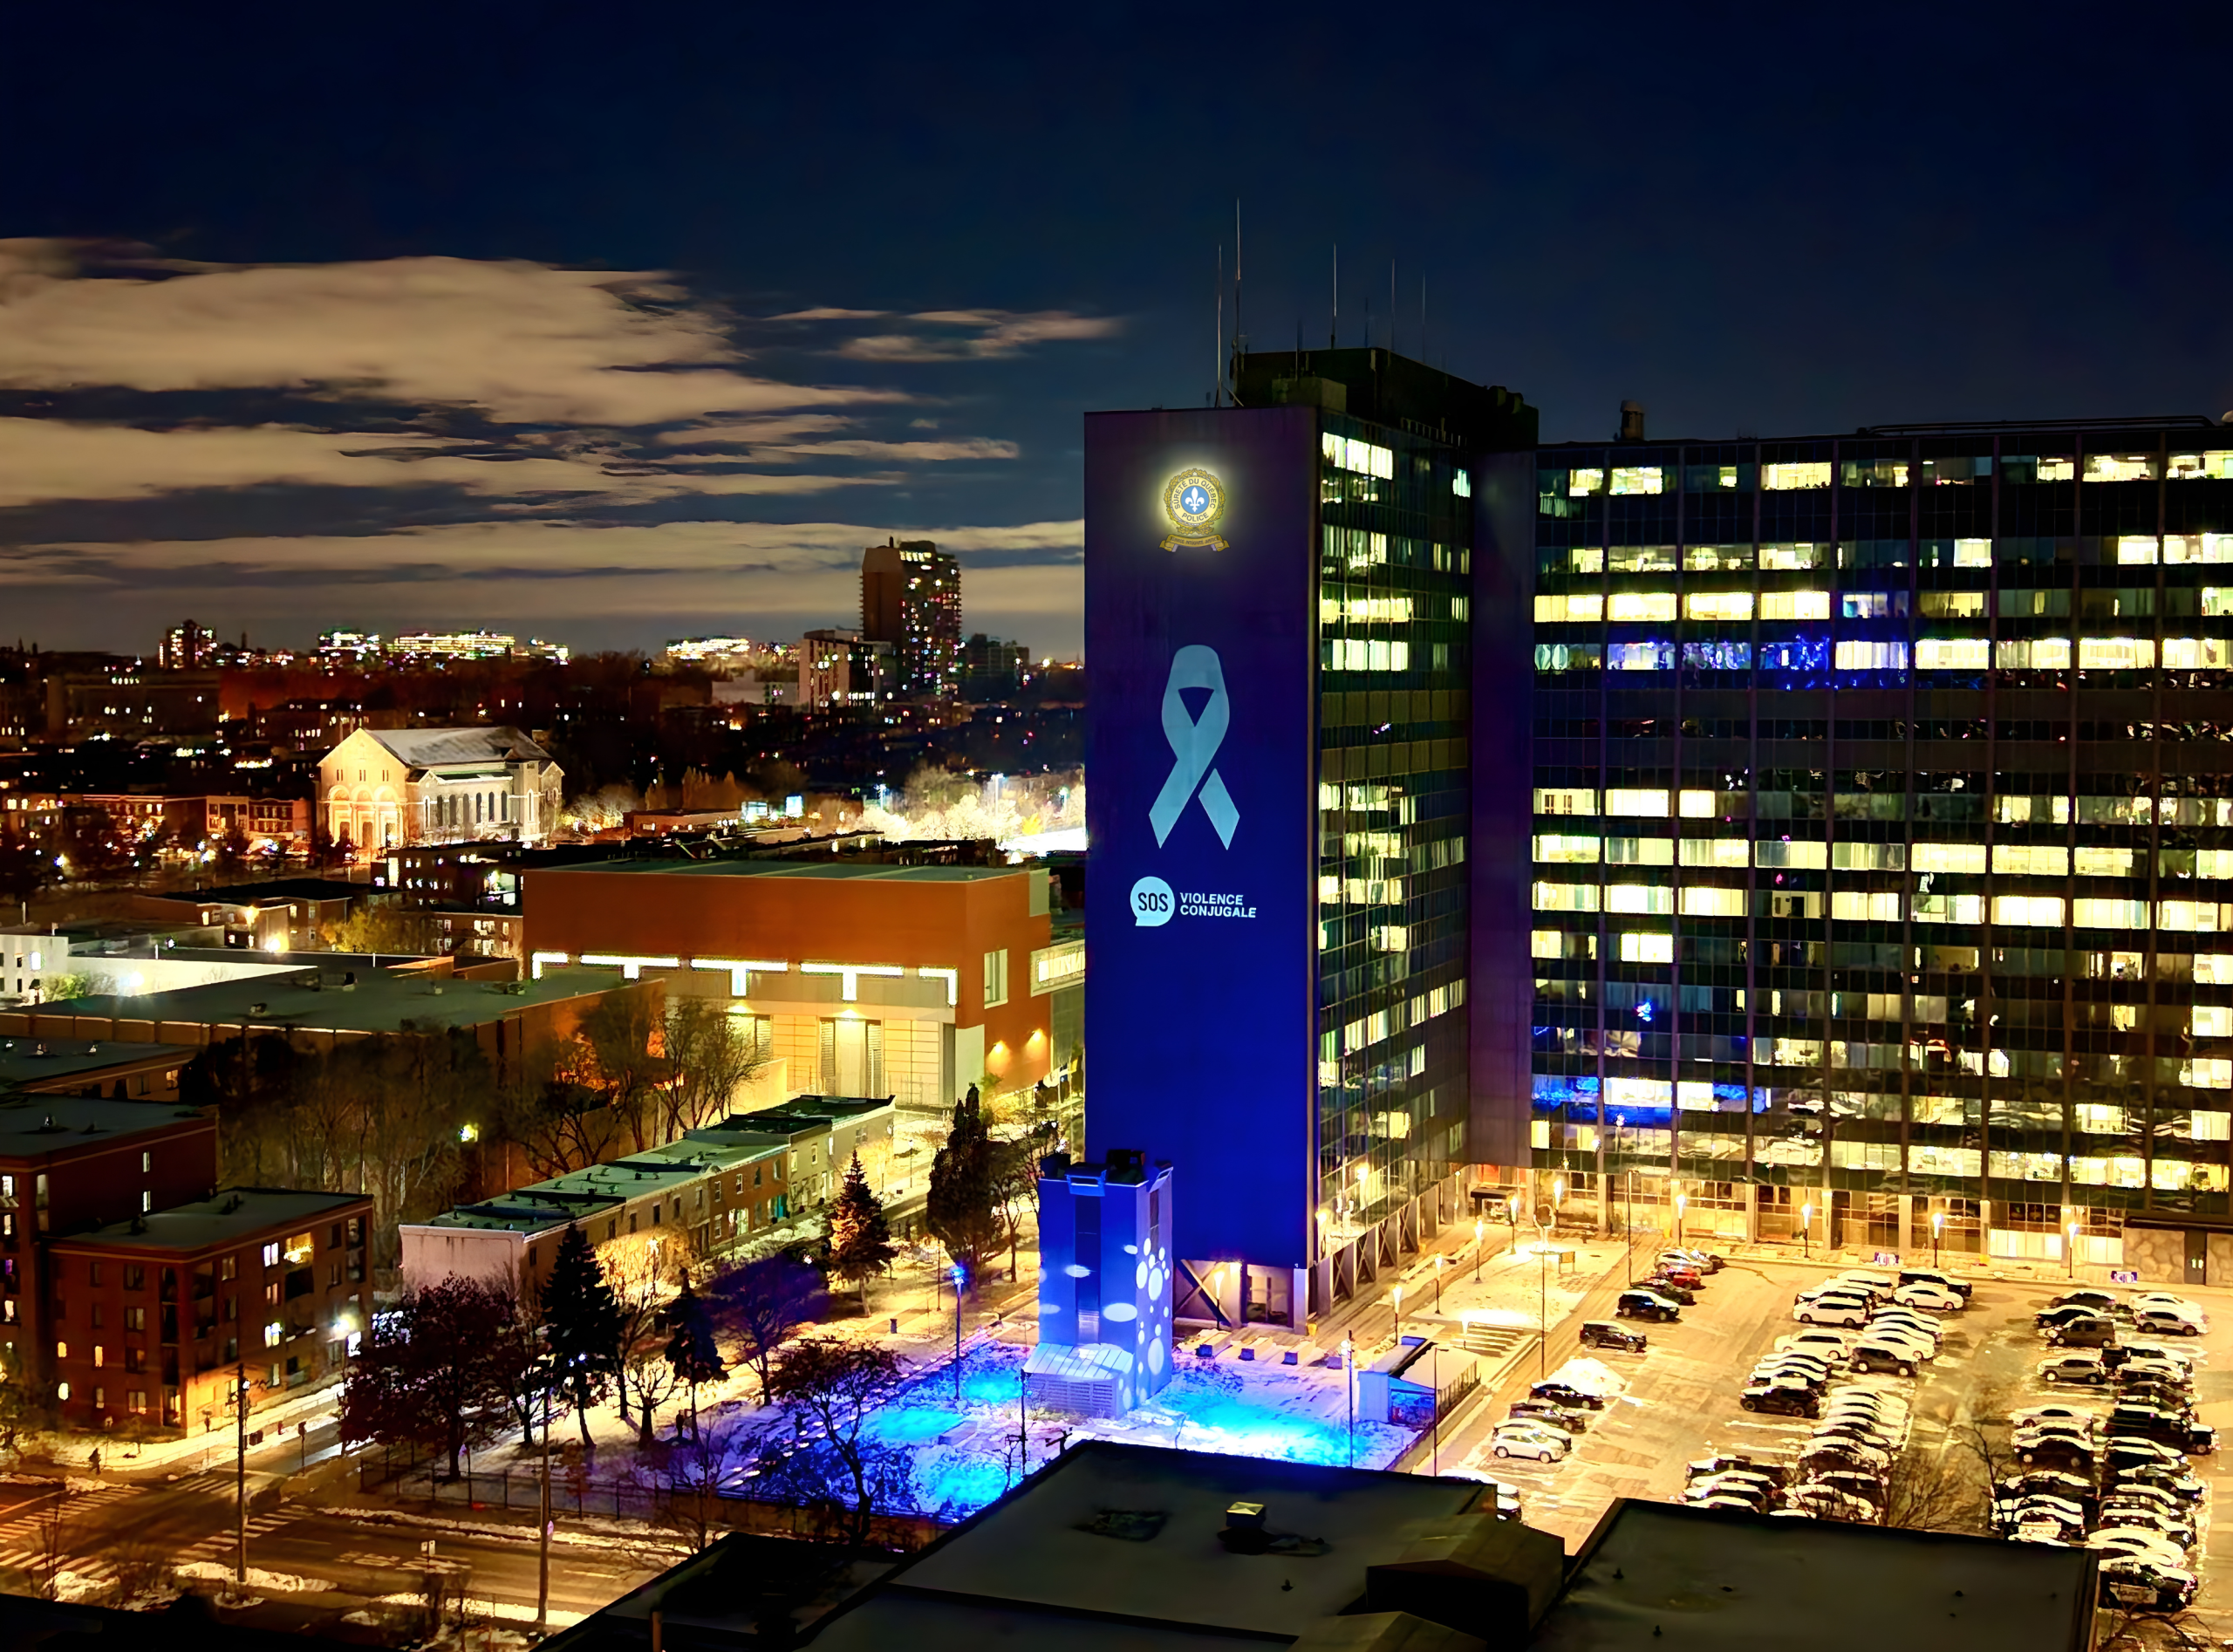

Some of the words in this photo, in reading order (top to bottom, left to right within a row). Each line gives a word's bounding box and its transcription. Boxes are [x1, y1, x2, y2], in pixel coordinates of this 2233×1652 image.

[1200, 480, 1217, 509] QUÉBEC
[1181, 512, 1209, 522] POLICE
[1137, 891, 1169, 912] SOS
[1179, 892, 1244, 905] VIOLENCE
[1179, 905, 1257, 918] CONJUGALE
